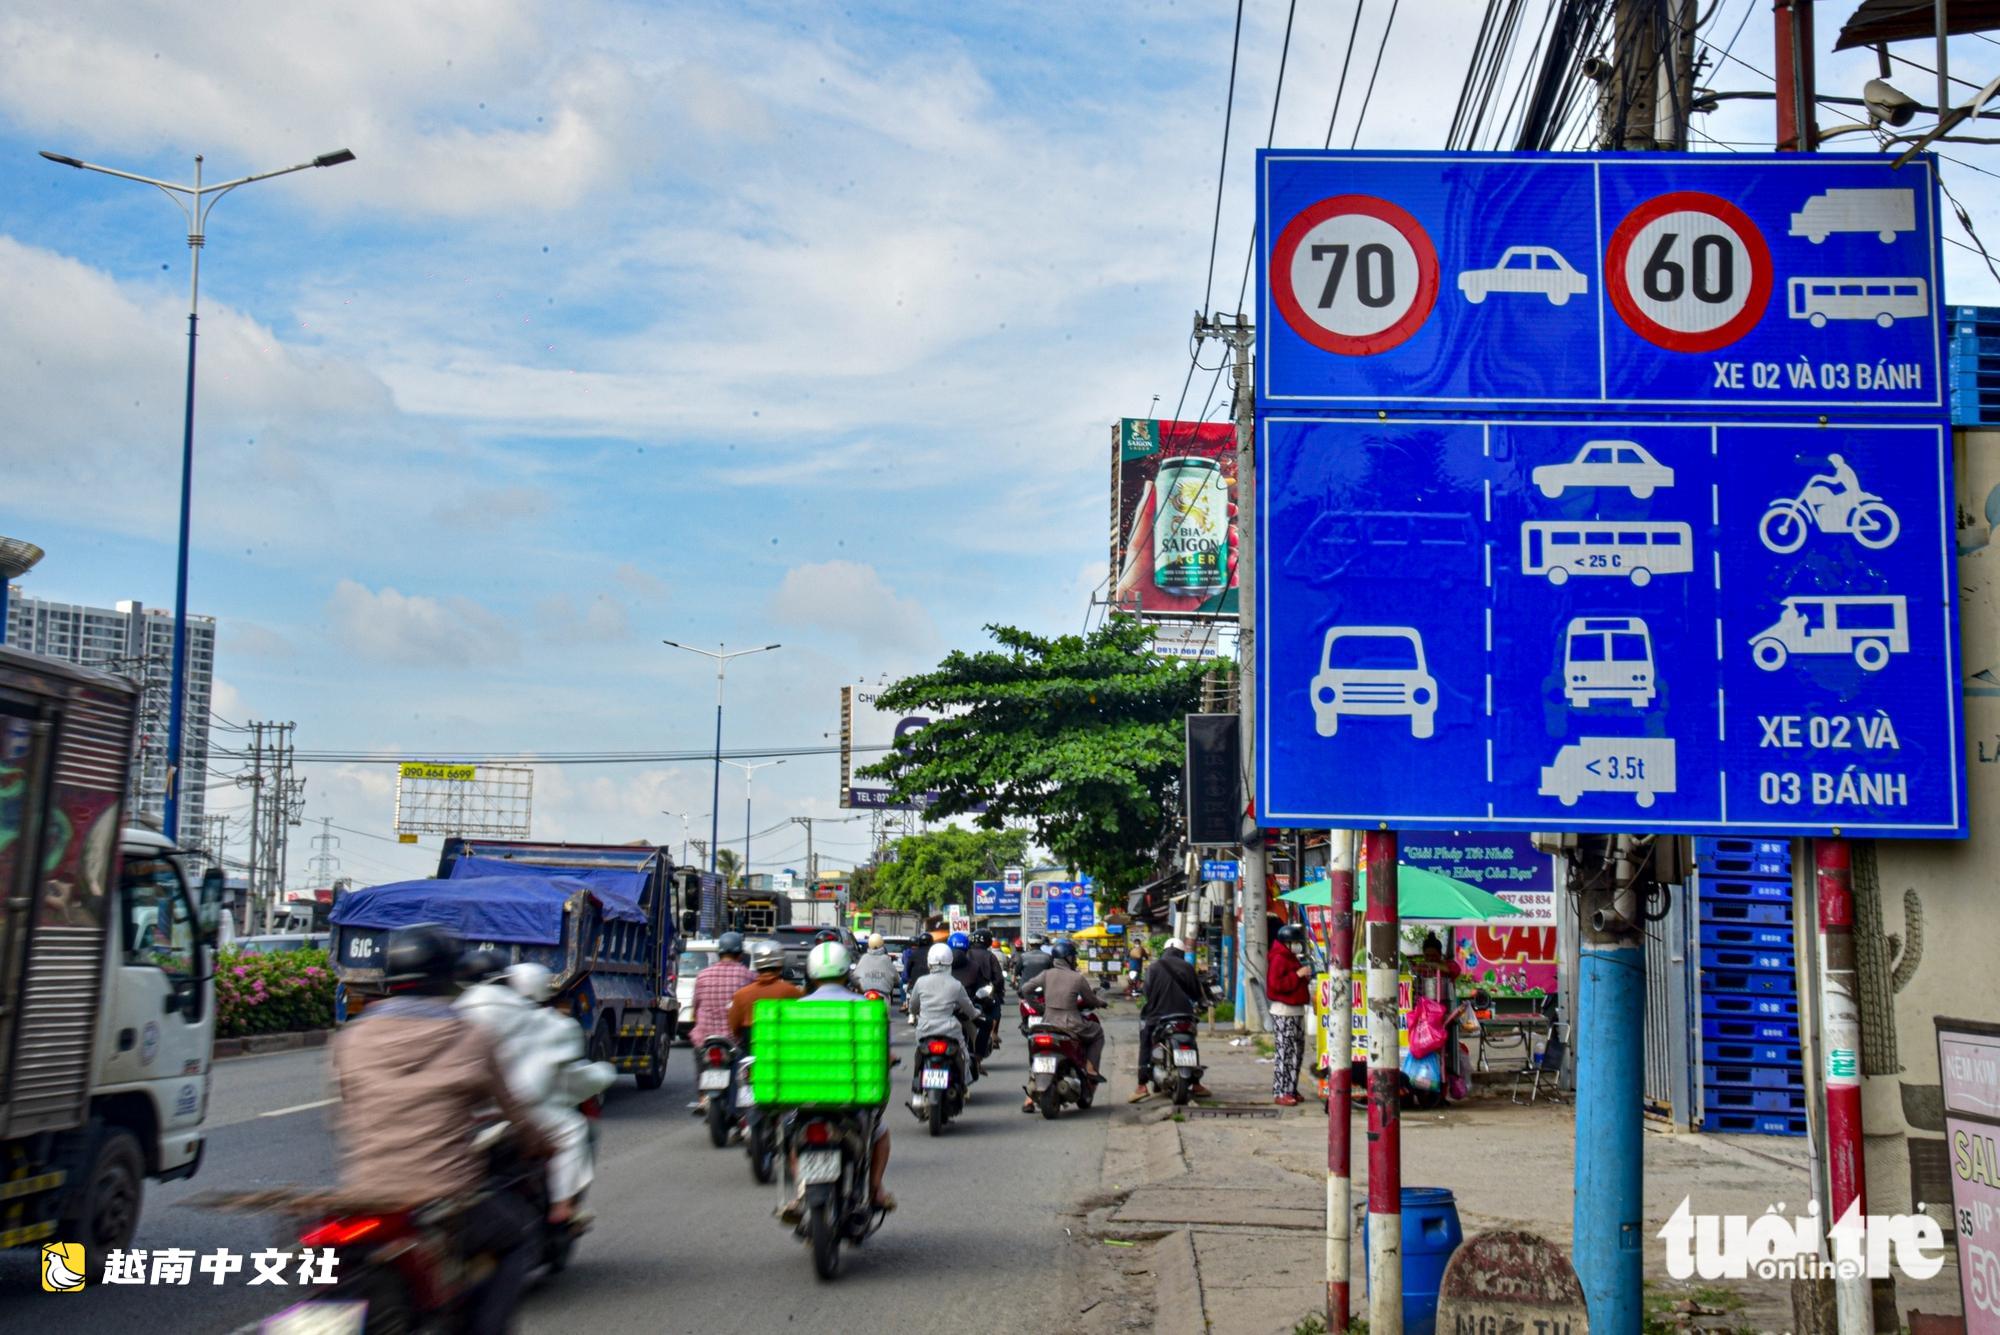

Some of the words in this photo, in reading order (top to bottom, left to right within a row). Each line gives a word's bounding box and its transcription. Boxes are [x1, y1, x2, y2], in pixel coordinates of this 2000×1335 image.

[1310, 243, 1396, 310] 70
[1642, 233, 1735, 305] 60
[1713, 361, 1745, 389] XE
[1752, 361, 1781, 389] 02
[1786, 354, 1817, 389] VÀ
[1820, 362, 1851, 390] 03
[1855, 357, 1922, 391] BÁNH
[1180, 527, 1201, 537] BIA
[1161, 538, 1220, 553] SAIGON
[1166, 554, 1217, 565] LAGER
[1589, 554, 1608, 568] 25
[1611, 554, 1622, 568] C
[1757, 715, 1803, 748] XE
[1809, 715, 1852, 749] 02
[1856, 708, 1900, 749] VÀ
[404, 767, 423, 777] 090
[425, 768, 444, 777] 464
[447, 769, 472, 779] 6699
[1608, 756, 1645, 780] 3.5t
[1760, 771, 1801, 805] 03
[1811, 764, 1908, 806] BÁNH
[1959, 1208, 1974, 1237] 35
